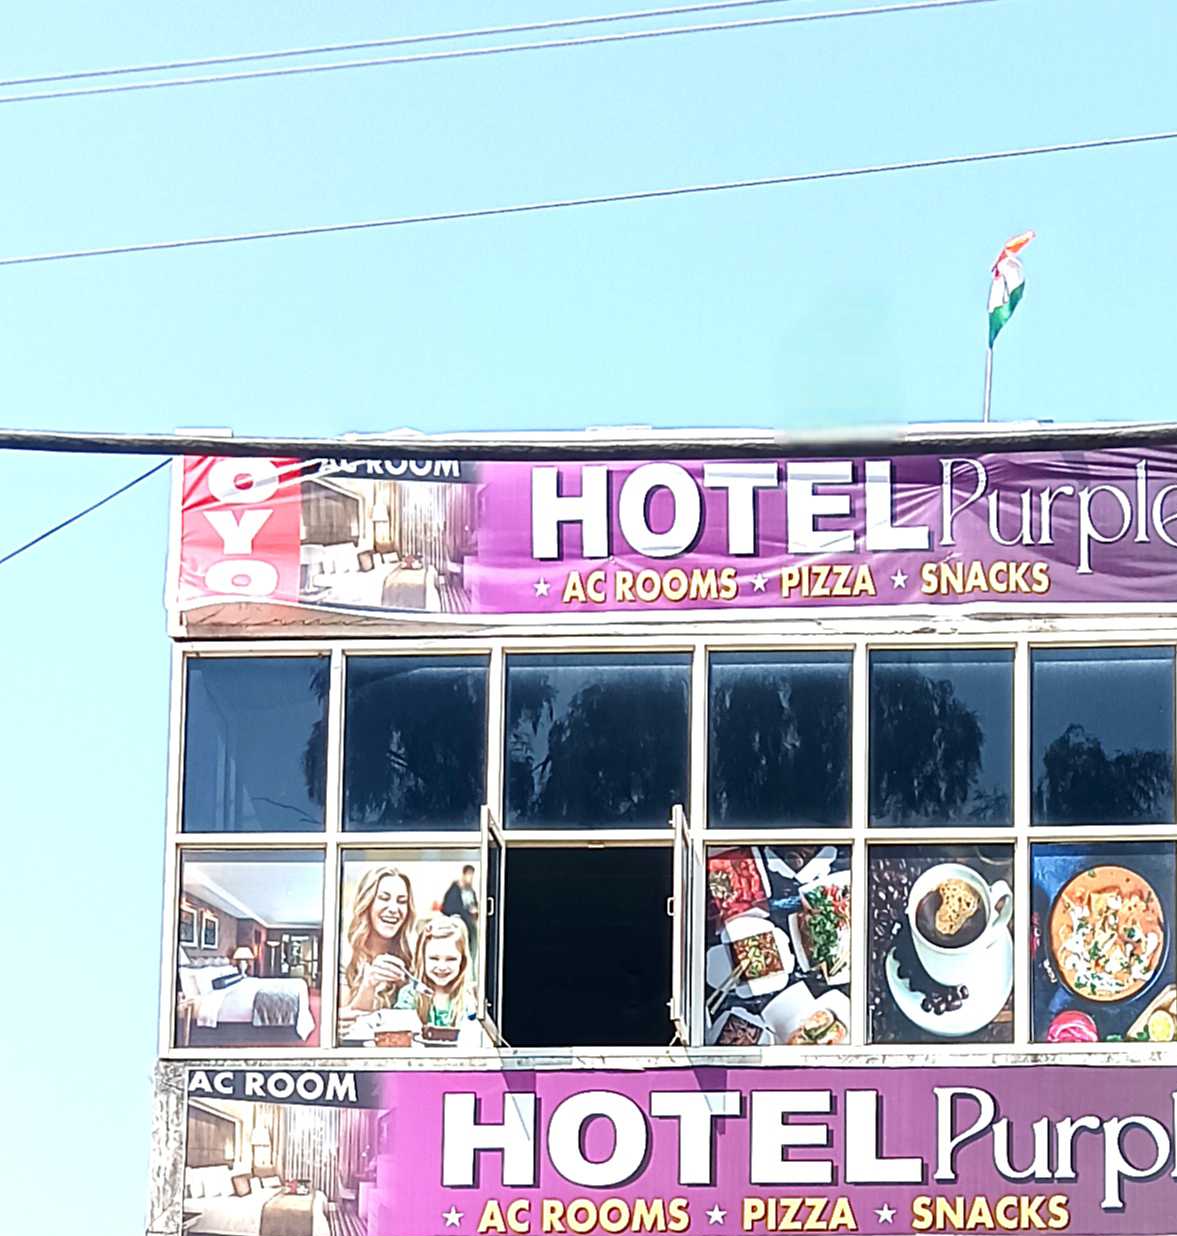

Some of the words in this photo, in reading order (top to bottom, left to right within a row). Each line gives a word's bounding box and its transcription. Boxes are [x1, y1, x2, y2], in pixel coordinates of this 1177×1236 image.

[203, 457, 280, 597] OYO
[531, 460, 930, 560] HOTEL
[562, 569, 606, 603] AC
[615, 567, 738, 601] ROOMS
[780, 565, 876, 598] PIZZA
[921, 560, 1051, 595] SNACKS
[188, 1071, 234, 1095] AC
[245, 1071, 358, 1102] ROOM
[441, 1089, 926, 1188] HOTEL
[477, 1198, 530, 1233] AC
[542, 1197, 690, 1233] ROOMS
[742, 1196, 858, 1232] PIZZA
[911, 1194, 1071, 1231] SNACKS
